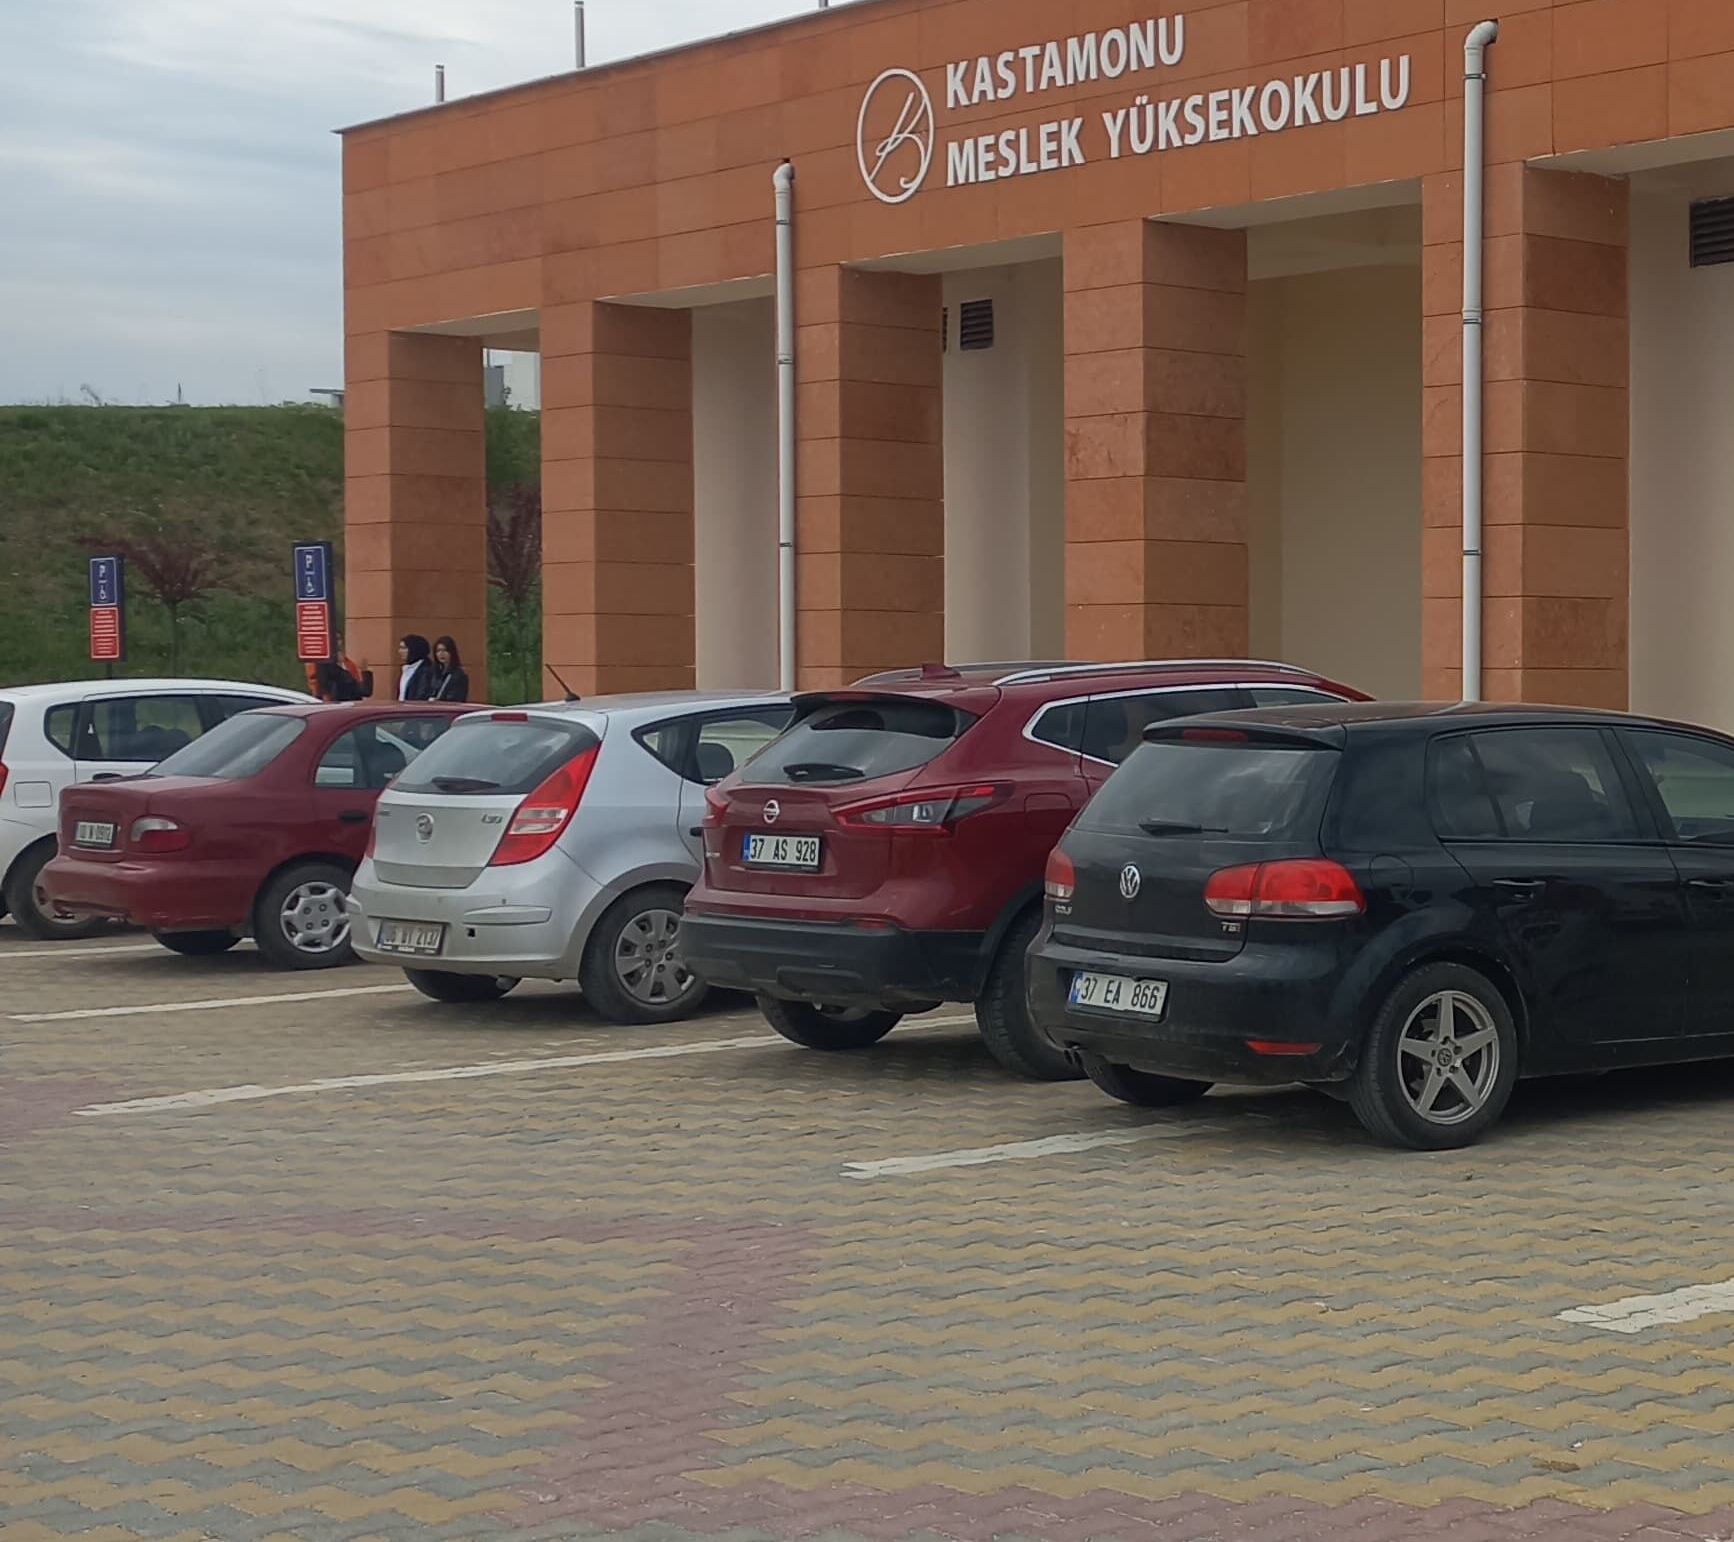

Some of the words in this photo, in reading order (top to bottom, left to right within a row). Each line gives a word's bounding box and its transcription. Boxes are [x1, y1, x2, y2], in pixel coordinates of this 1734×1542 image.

[946, 14, 1185, 108] KASTAMONU
[946, 117, 1085, 187] MESLEK
[1102, 54, 1410, 160] YÜKSEKOKULU
[751, 838, 764, 860] 37
[773, 839, 788, 861] AS
[795, 840, 816, 862] 928
[1081, 976, 1097, 1002] 37
[1104, 979, 1122, 1005] EA
[1131, 984, 1160, 1010] 866
